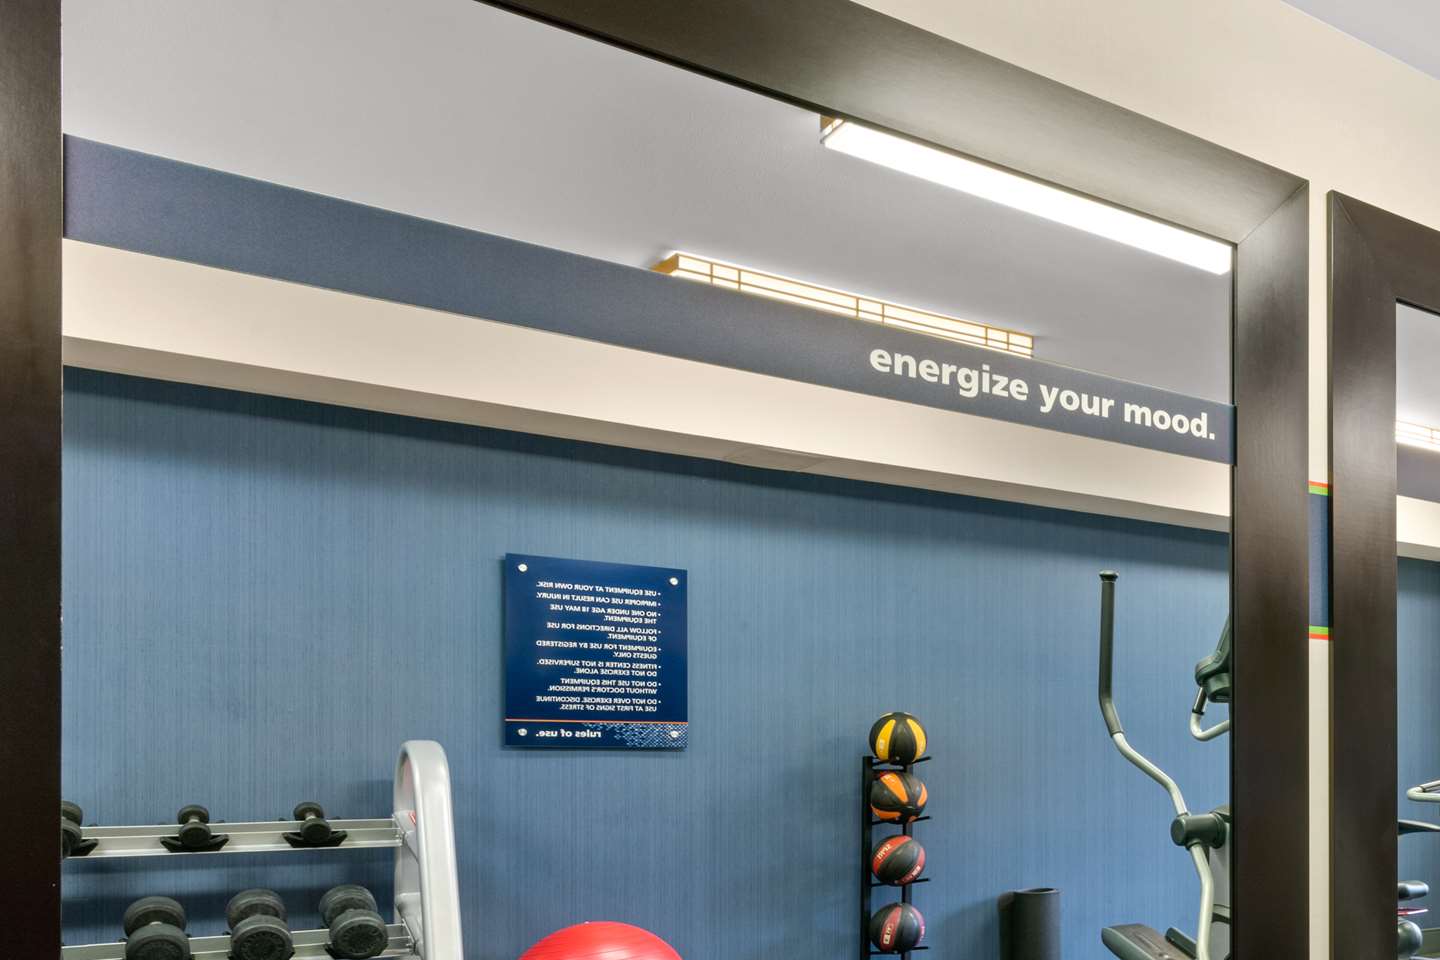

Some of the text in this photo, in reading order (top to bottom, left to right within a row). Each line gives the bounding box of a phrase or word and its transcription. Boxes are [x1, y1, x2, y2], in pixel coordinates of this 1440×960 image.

[869, 347, 1216, 440] energize your mood.
